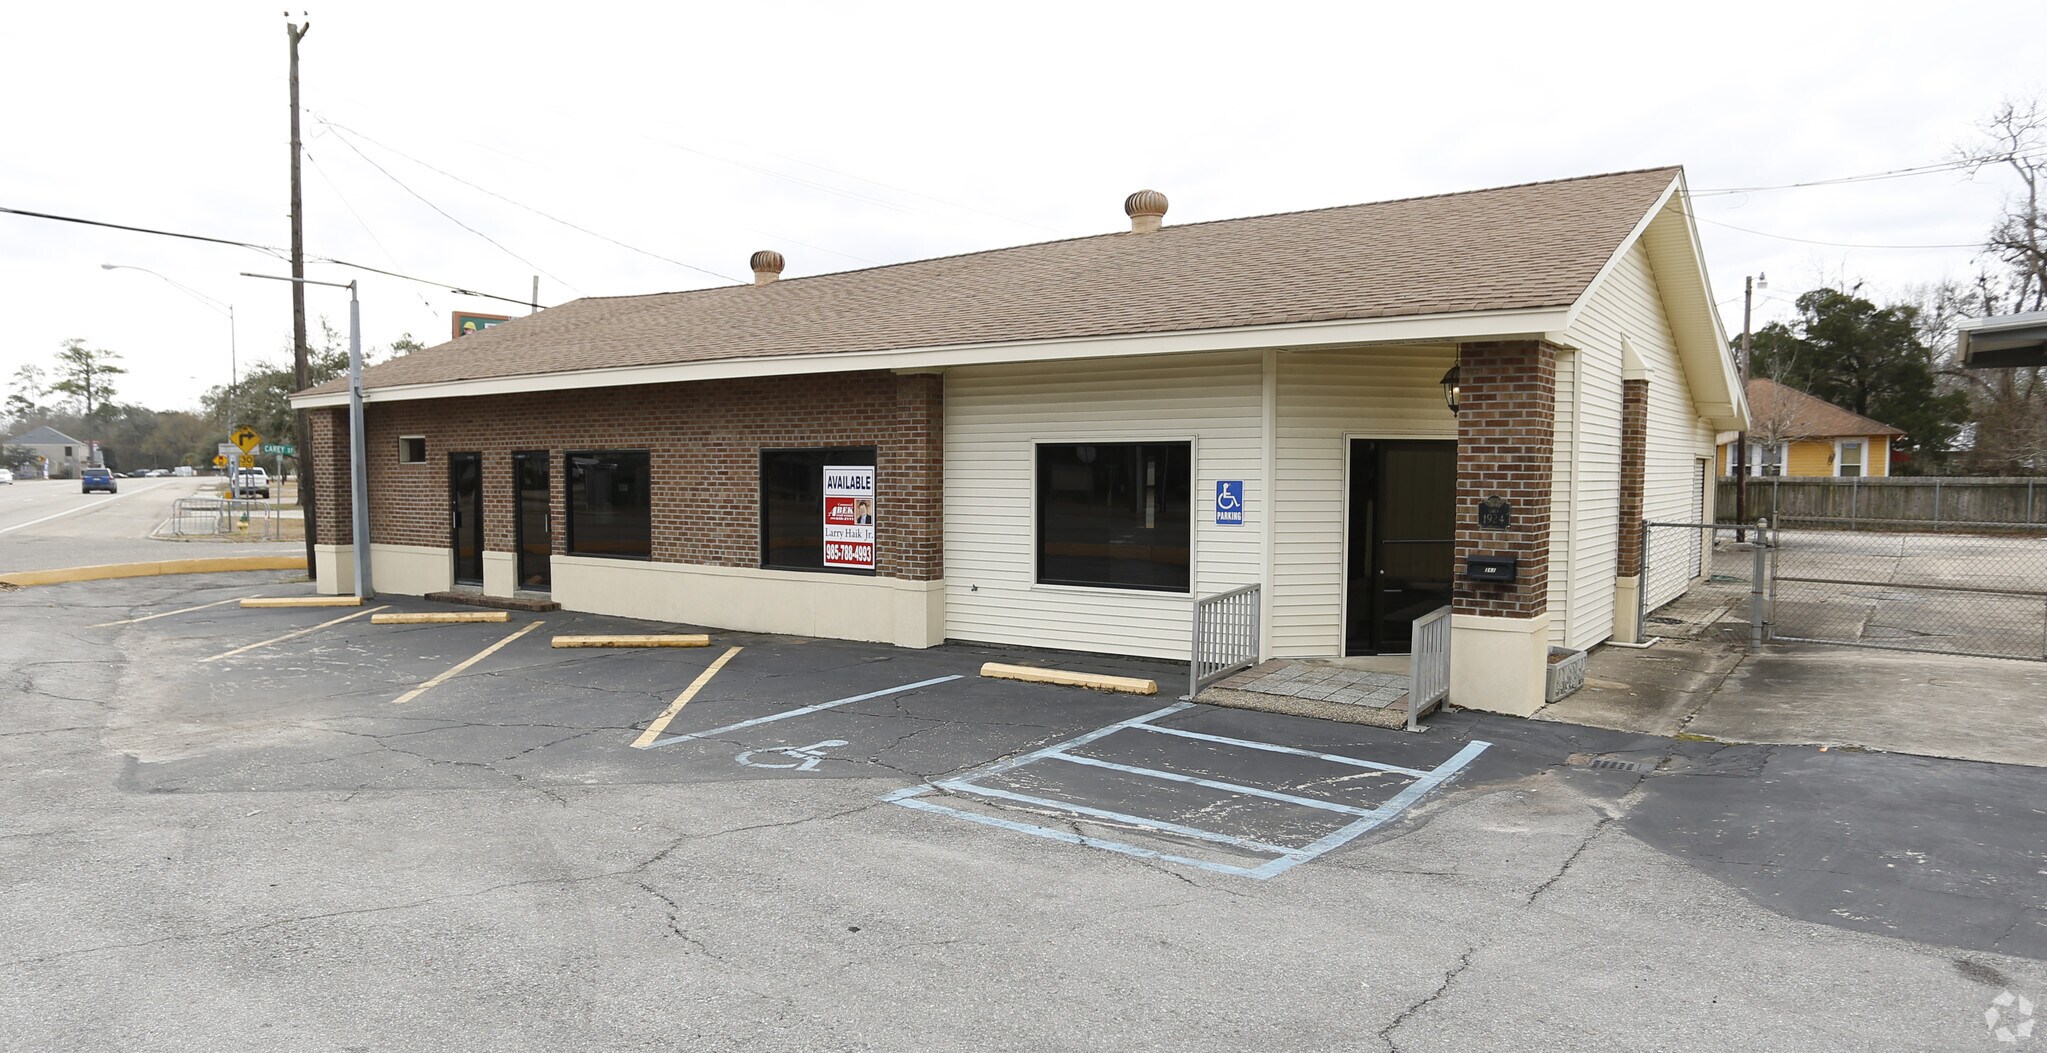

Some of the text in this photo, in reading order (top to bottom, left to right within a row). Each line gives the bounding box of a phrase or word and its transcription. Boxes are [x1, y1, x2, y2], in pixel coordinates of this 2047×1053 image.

[264, 445, 284, 453] CAREY
[240, 456, 252, 464] 30
[827, 475, 871, 489] AVAILABLE
[1217, 511, 1242, 520] PARKING
[1483, 513, 1505, 524] 1924
[825, 527, 873, 541] Larry Haik Jr.
[826, 543, 872, 562] 985-788-4993
